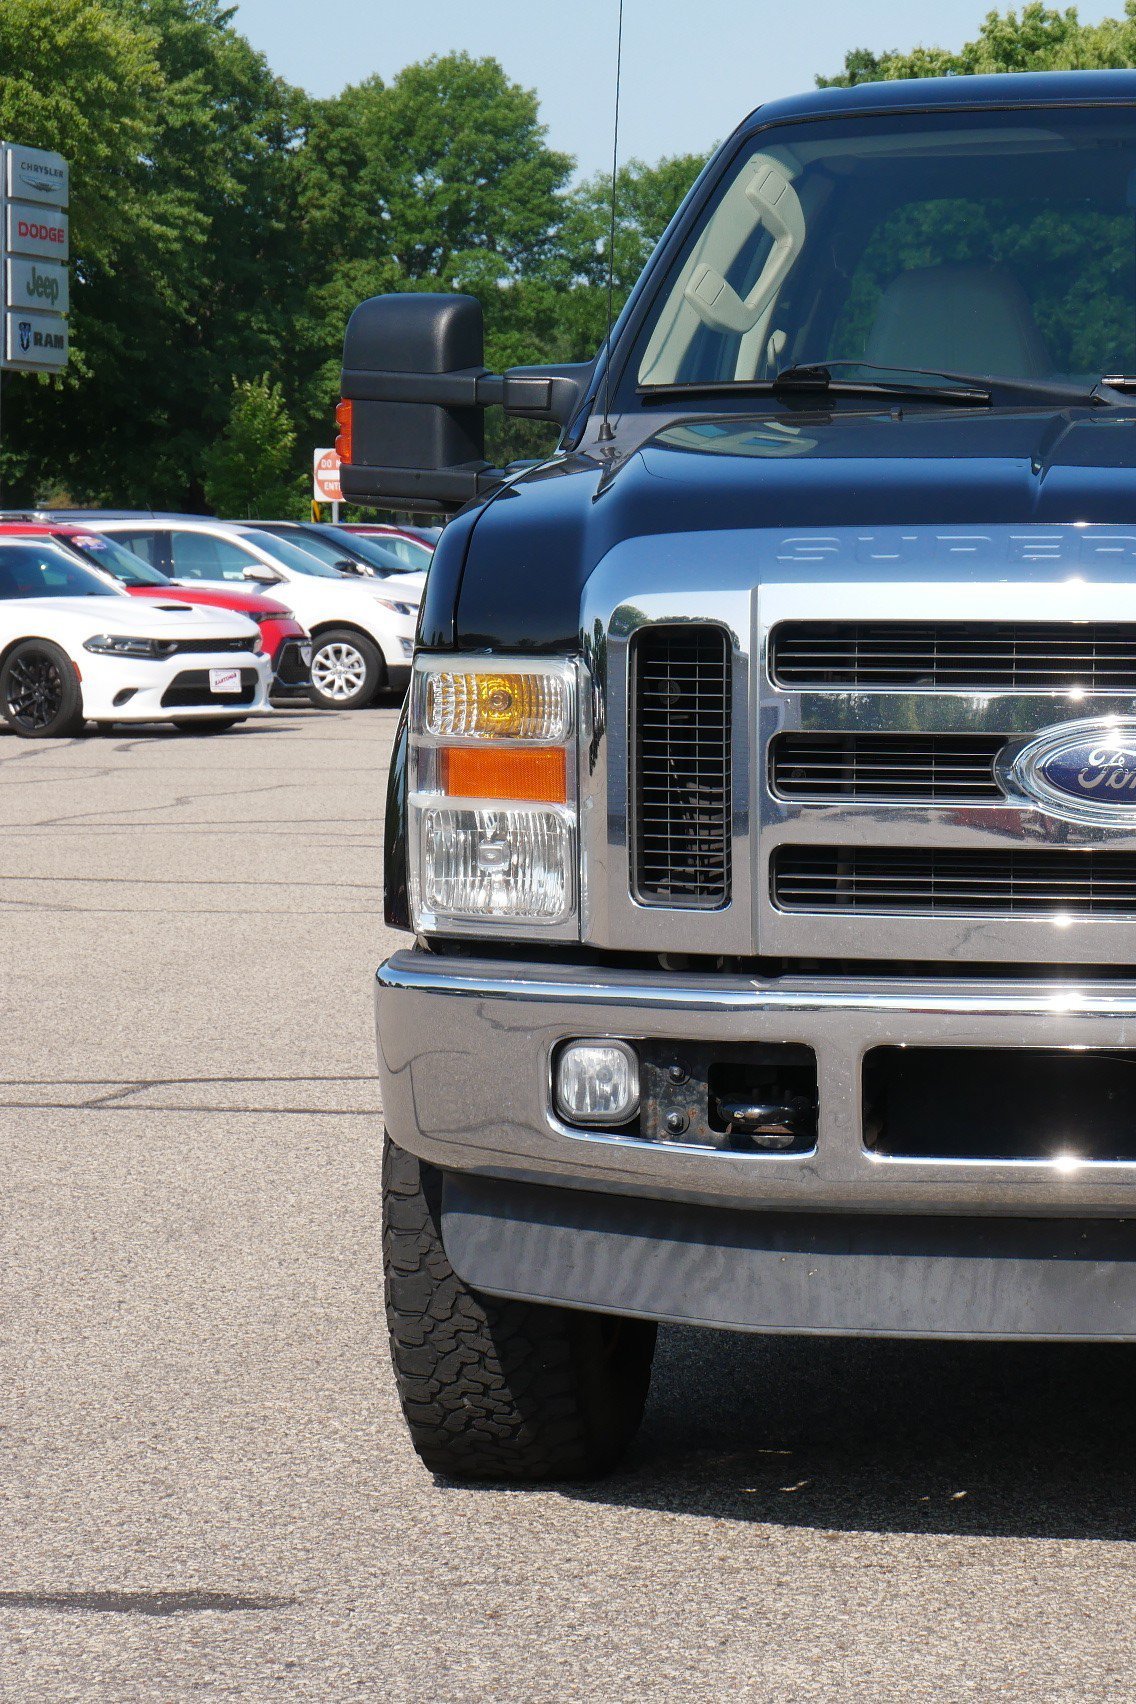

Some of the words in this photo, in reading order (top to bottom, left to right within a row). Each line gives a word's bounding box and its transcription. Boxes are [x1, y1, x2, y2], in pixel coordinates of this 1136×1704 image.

[20, 161, 64, 178] CHRYSLER
[17, 221, 65, 243] DODGE
[26, 266, 59, 306] Jeep
[33, 331, 65, 349] RAM
[320, 459, 332, 469] DO
[323, 481, 341, 491] ENT
